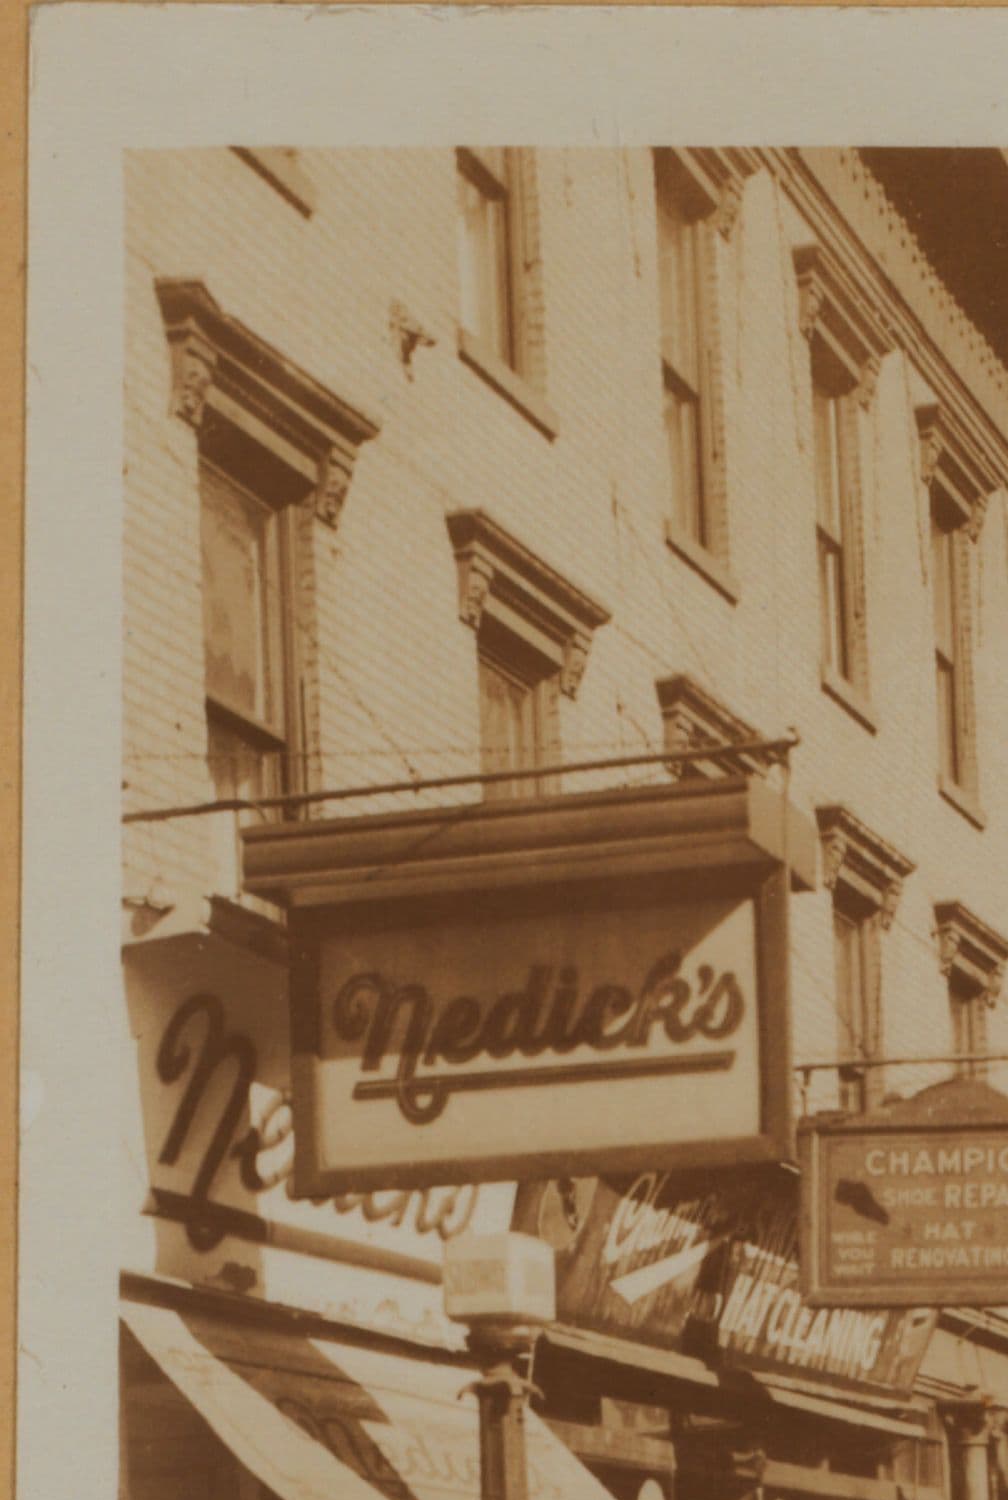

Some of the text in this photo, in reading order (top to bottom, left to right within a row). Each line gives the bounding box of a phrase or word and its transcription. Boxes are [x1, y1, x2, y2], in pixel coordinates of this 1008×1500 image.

[333, 953, 745, 1125] Nedick's
[883, 1187, 937, 1208] SHOE
[924, 1219, 977, 1240] HAT
[838, 1247, 875, 1260] YOU
[764, 1284, 886, 1371] CLEANING
